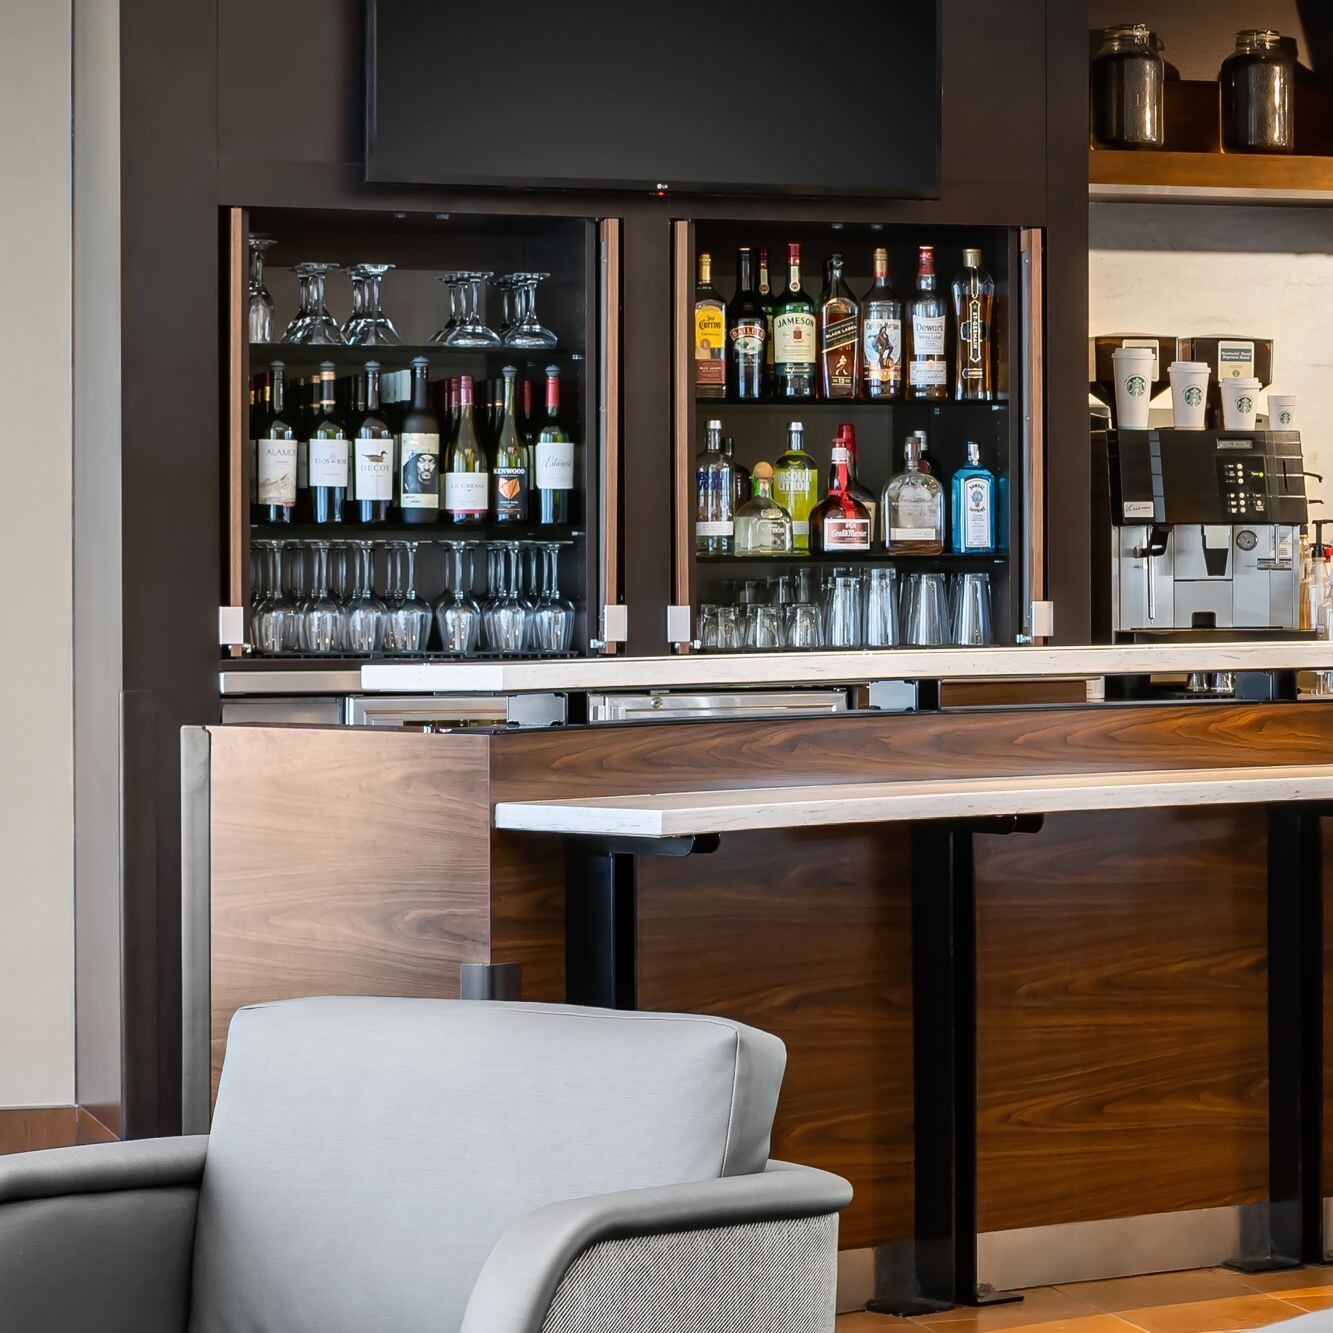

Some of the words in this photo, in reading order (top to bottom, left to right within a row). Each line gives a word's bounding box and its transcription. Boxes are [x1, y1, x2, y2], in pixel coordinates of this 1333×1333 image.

[699, 319, 721, 330] Cuervo
[778, 317, 814, 328] JAMESON
[732, 327, 763, 337] BAILEYS
[361, 464, 390, 472] DECOY
